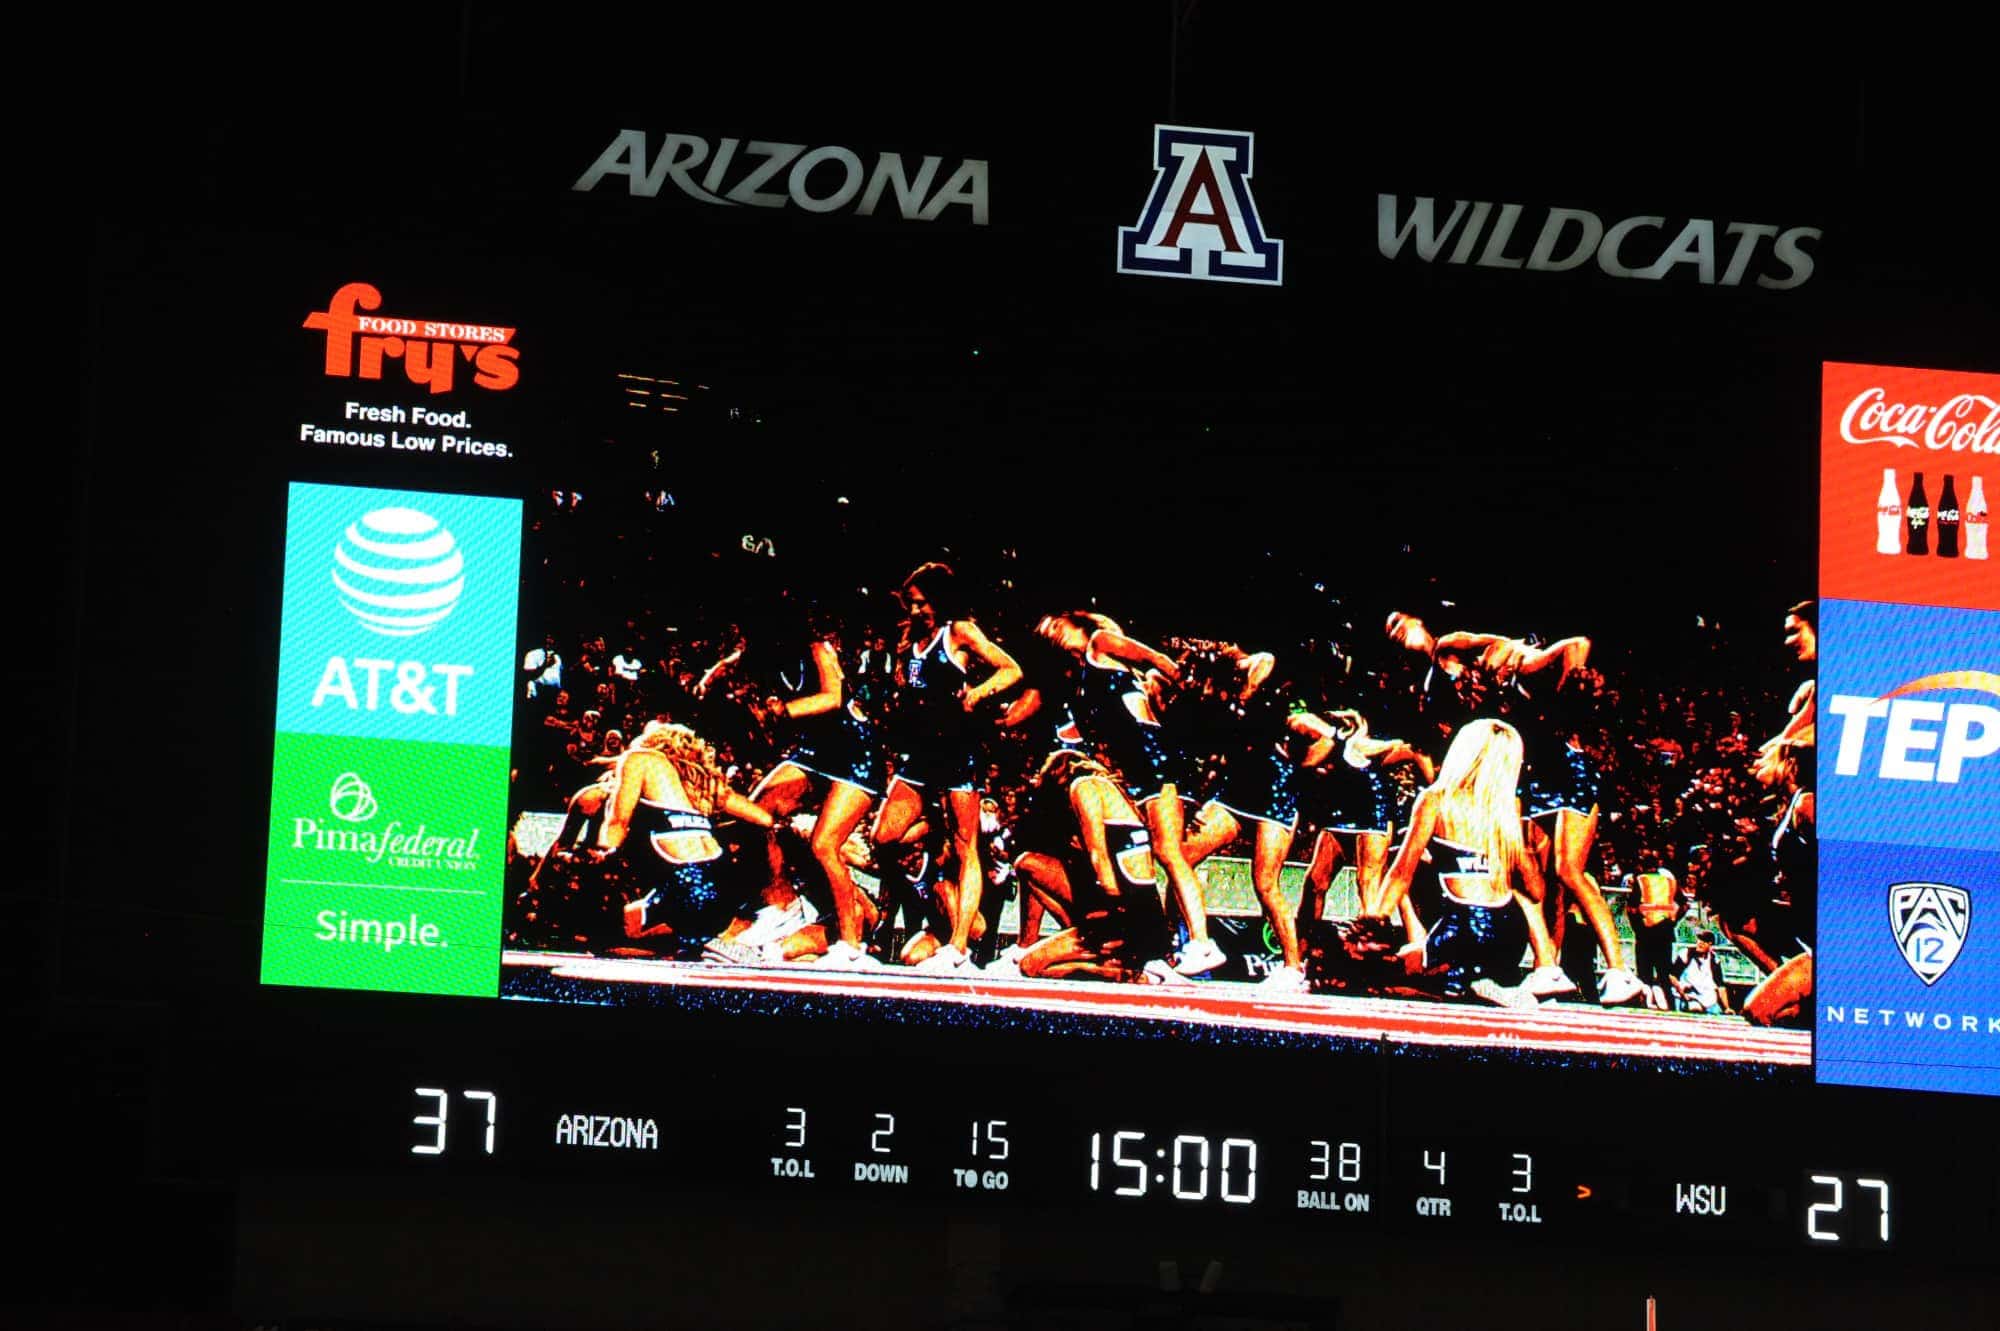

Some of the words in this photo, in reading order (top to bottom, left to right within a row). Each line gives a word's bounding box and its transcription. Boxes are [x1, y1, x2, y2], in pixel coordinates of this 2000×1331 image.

[571, 128, 989, 225] ARIZONA
[1117, 124, 1283, 286] A
[1377, 193, 1823, 290] WILDCATS
[302, 282, 520, 394] fry's
[358, 315, 417, 334] FOOD
[424, 322, 506, 343] STORES
[345, 402, 406, 424] Fresh
[411, 407, 472, 429] Food.
[300, 423, 386, 448] Famous
[391, 431, 436, 453] Low
[441, 435, 514, 458] Prices.
[310, 655, 475, 716] AT&T
[1829, 694, 2000, 784] TEP
[314, 909, 449, 953] Simple.
[1893, 887, 1966, 943] PAC
[1915, 937, 1944, 964] 12
[411, 1087, 496, 1154] 37
[555, 1113, 659, 1150] ARIZONA
[784, 1107, 806, 1148] 3
[871, 1113, 894, 1153] 2
[971, 1120, 1009, 1160] 15
[770, 1157, 815, 1179] T.O.L
[854, 1162, 908, 1184] DOWN
[953, 1168, 978, 1188] TO
[982, 1170, 1009, 1190] GO
[1090, 1131, 1257, 1204] 15:00
[1309, 1140, 1361, 1182] 38
[1424, 1150, 1446, 1185] 4
[1511, 1153, 1532, 1193] 3
[1297, 1190, 1341, 1211] BALL
[1344, 1193, 1370, 1212] ON
[1416, 1196, 1452, 1217] QTR
[1498, 1202, 1543, 1224] T.O.L
[1675, 1183, 1727, 1216] WSU
[1807, 1175, 1889, 1242] 27
